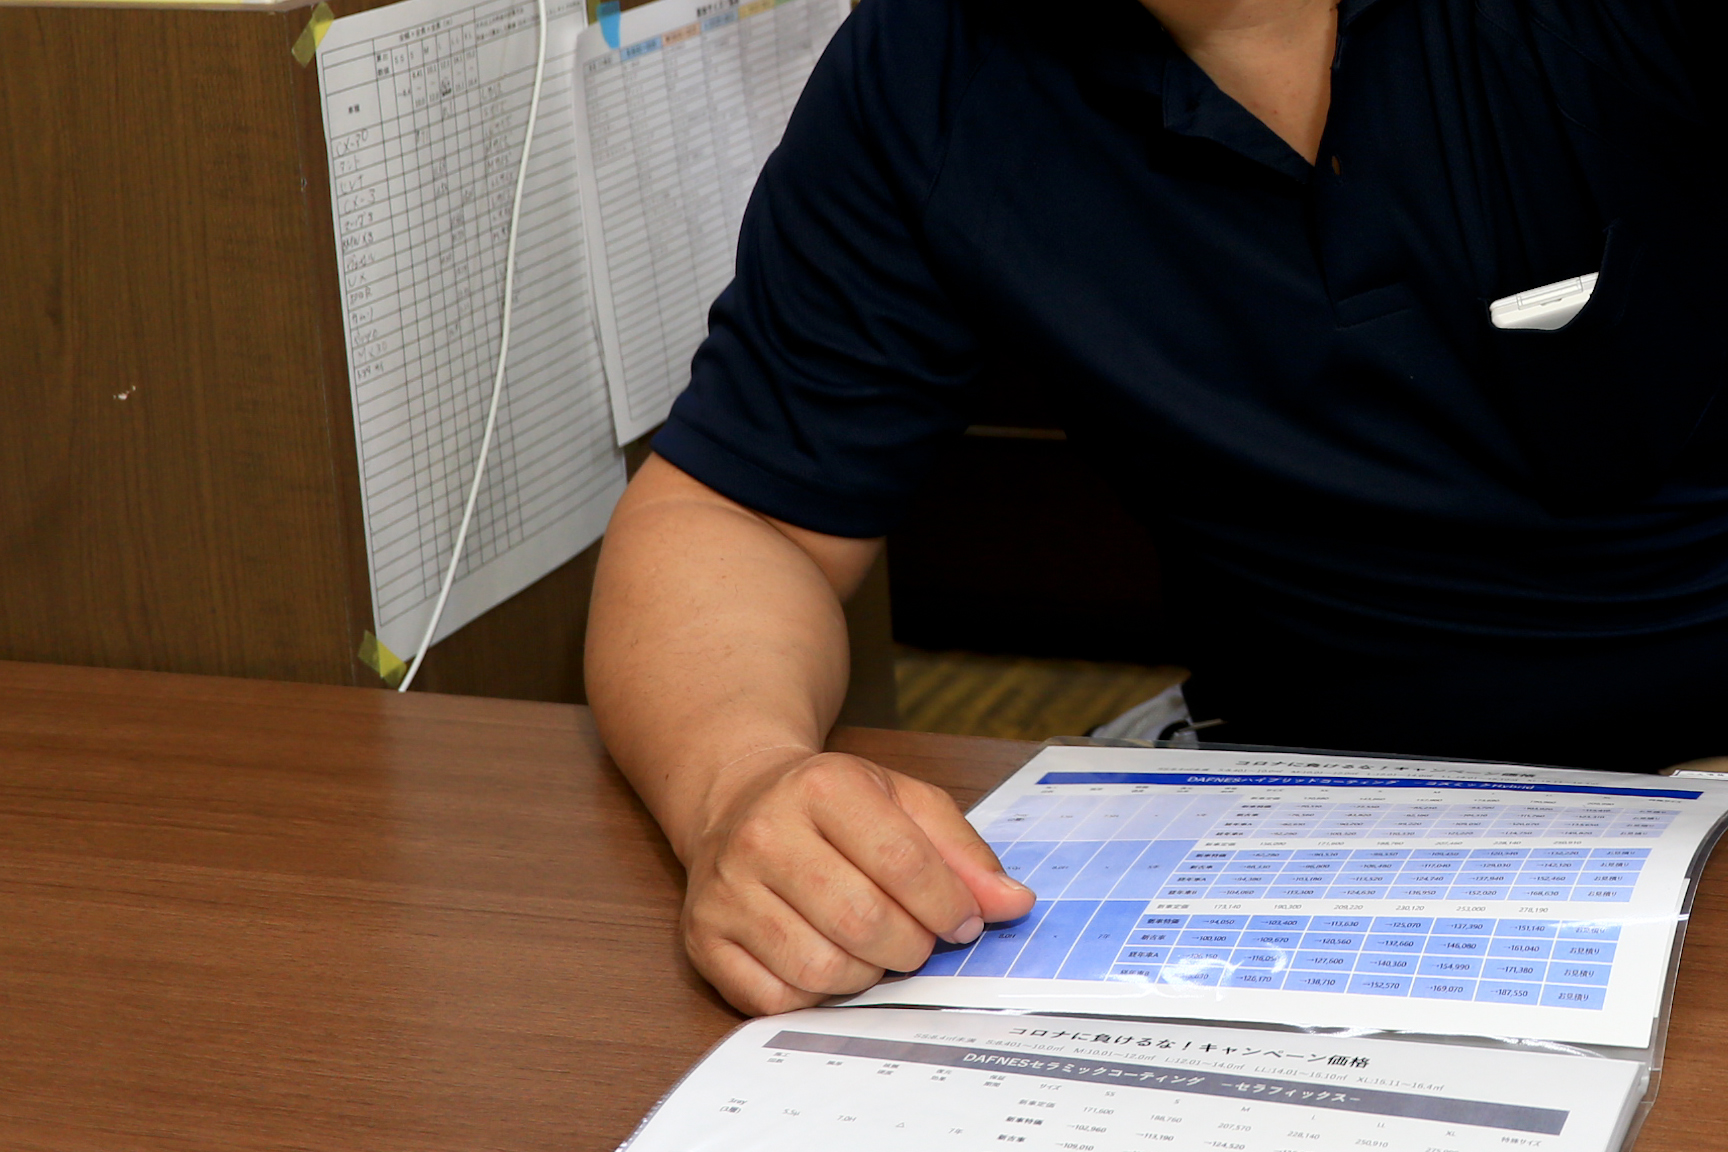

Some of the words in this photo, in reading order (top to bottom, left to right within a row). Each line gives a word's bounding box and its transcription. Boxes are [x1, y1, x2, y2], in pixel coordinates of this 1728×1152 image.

[1569, 947, 1600, 956] お見積り
[1563, 969, 1595, 978] お見積り
[1498, 988, 1528, 997] 187,550
[1558, 992, 1590, 1002] お見積り
[1009, 1027, 1371, 1069] コロナに負けるな！キャンペーン価格
[963, 1052, 1206, 1087] DAFNESセラミックコーティング
